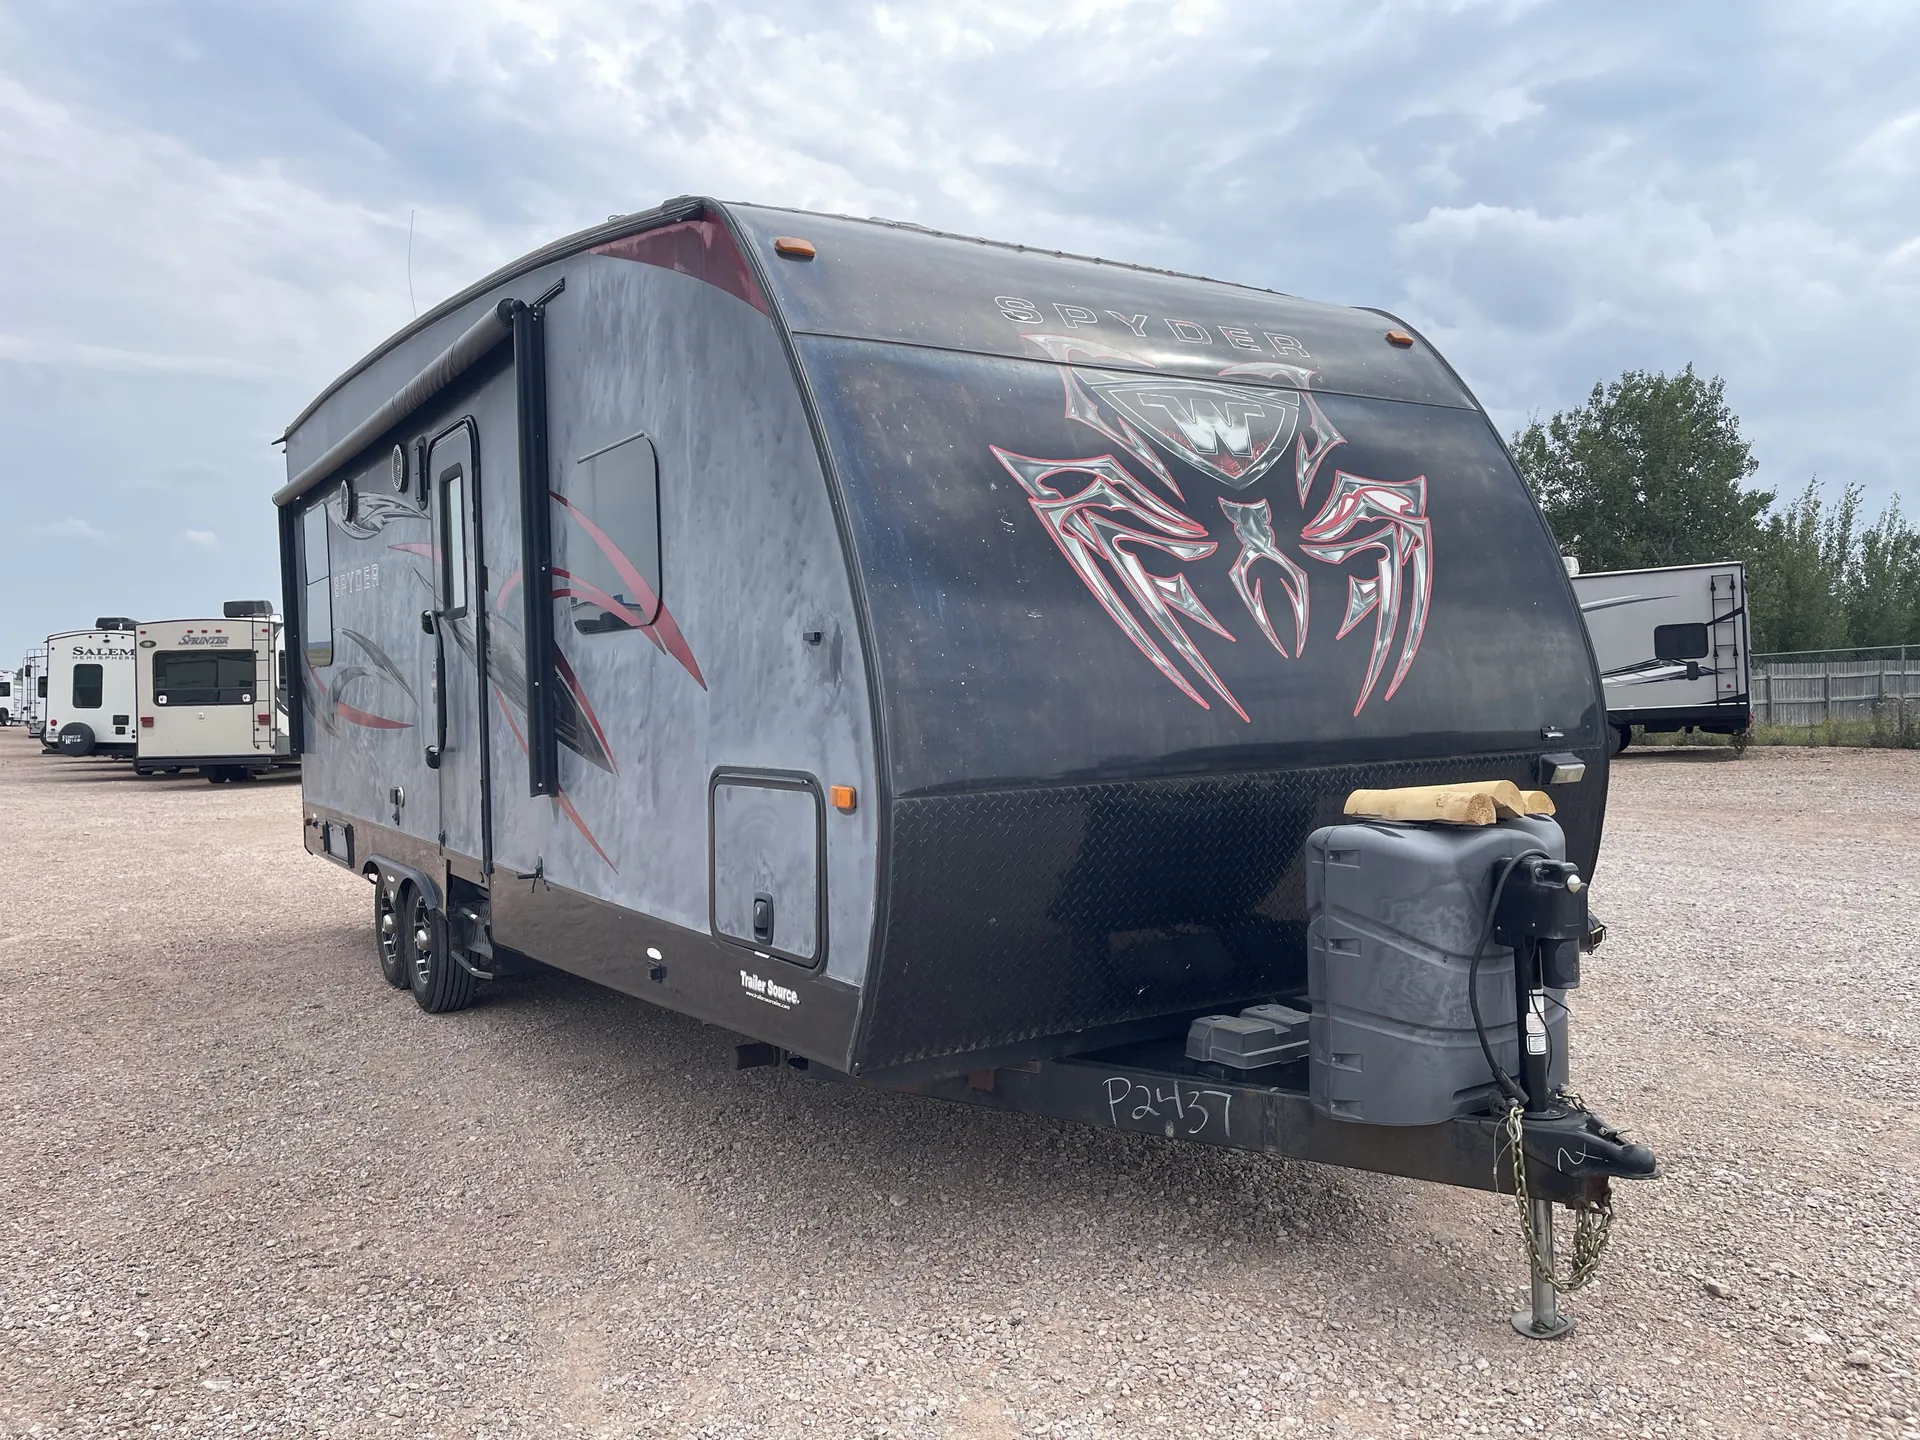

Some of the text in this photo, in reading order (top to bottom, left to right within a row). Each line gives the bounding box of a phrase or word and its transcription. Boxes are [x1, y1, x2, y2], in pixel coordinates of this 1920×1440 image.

[994, 295, 1311, 358] SPYDER
[333, 563, 379, 598] SPYDER
[72, 646, 135, 656] SALEM
[178, 634, 229, 645] SPRINTER
[740, 969, 767, 994] Trailer
[1102, 1077, 1233, 1140] P2437
